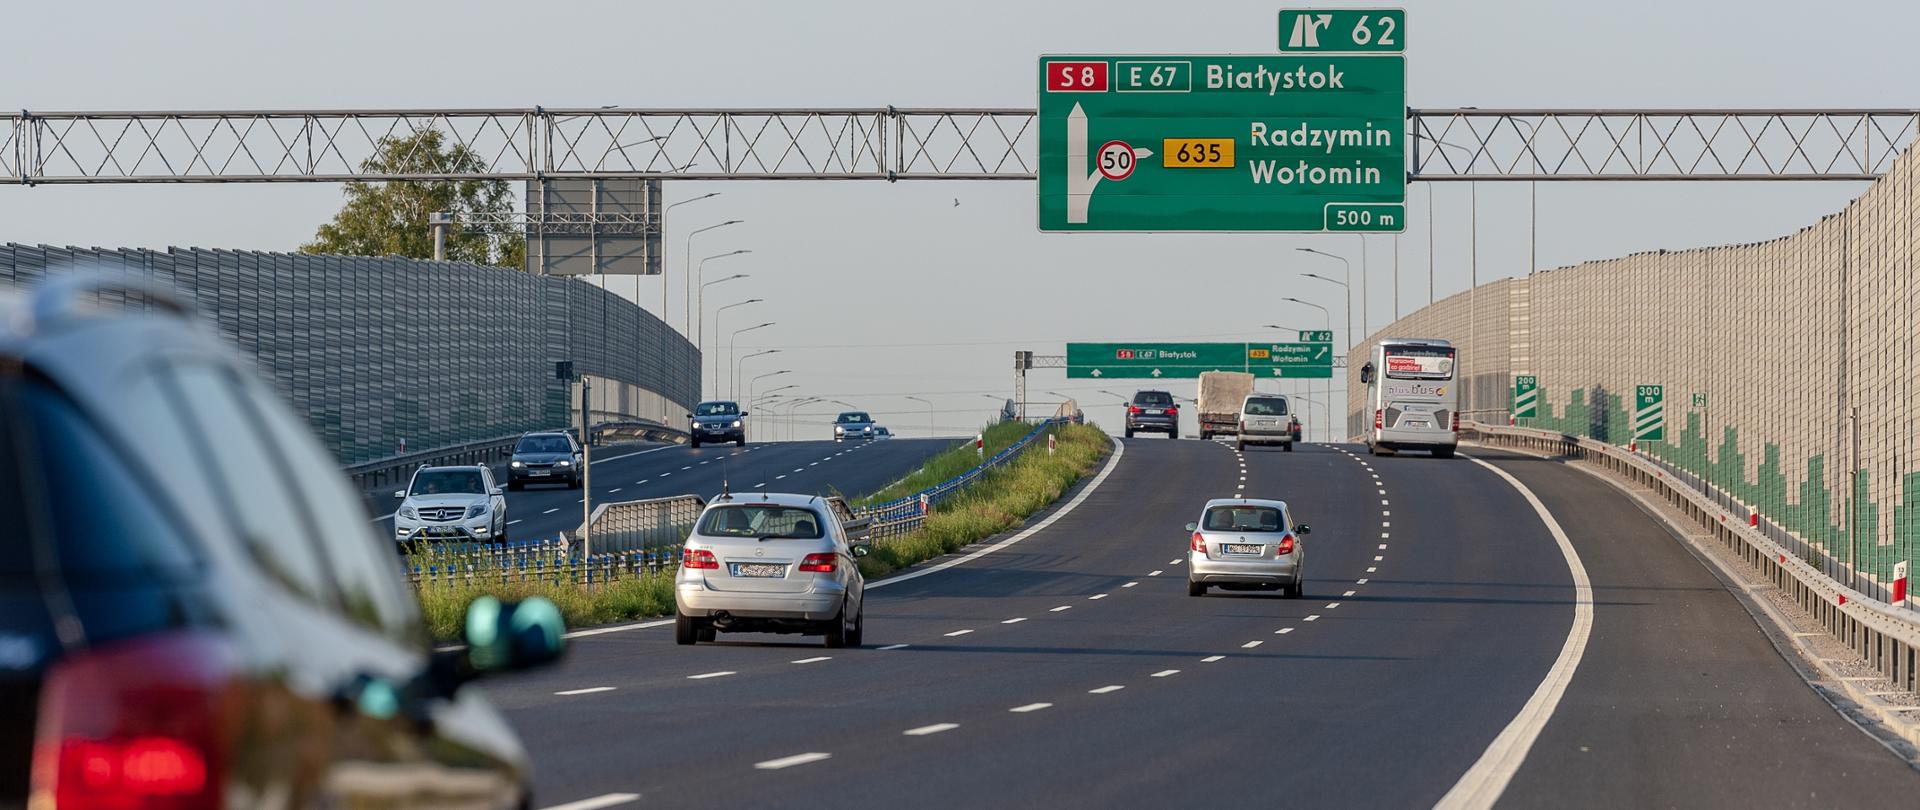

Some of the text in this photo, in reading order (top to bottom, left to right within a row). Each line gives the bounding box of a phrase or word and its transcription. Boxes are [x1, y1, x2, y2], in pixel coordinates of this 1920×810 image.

[1352, 16, 1395, 46] 62
[1061, 64, 1344, 96] S 8 E 67 Białystok
[1251, 122, 1391, 154] Radzymin
[1103, 152, 1131, 171] 50
[1176, 143, 1222, 164] 635
[1249, 160, 1380, 185] Wołomin
[1336, 210, 1394, 226] 500 m
[1318, 332, 1331, 341] 62
[1144, 350, 1153, 358] 67
[1159, 350, 1197, 360] Białystok
[1271, 345, 1311, 354] Radzymin
[1271, 355, 1308, 363] Wołomin
[1518, 377, 1534, 385] 200
[1639, 386, 1660, 396] 300
